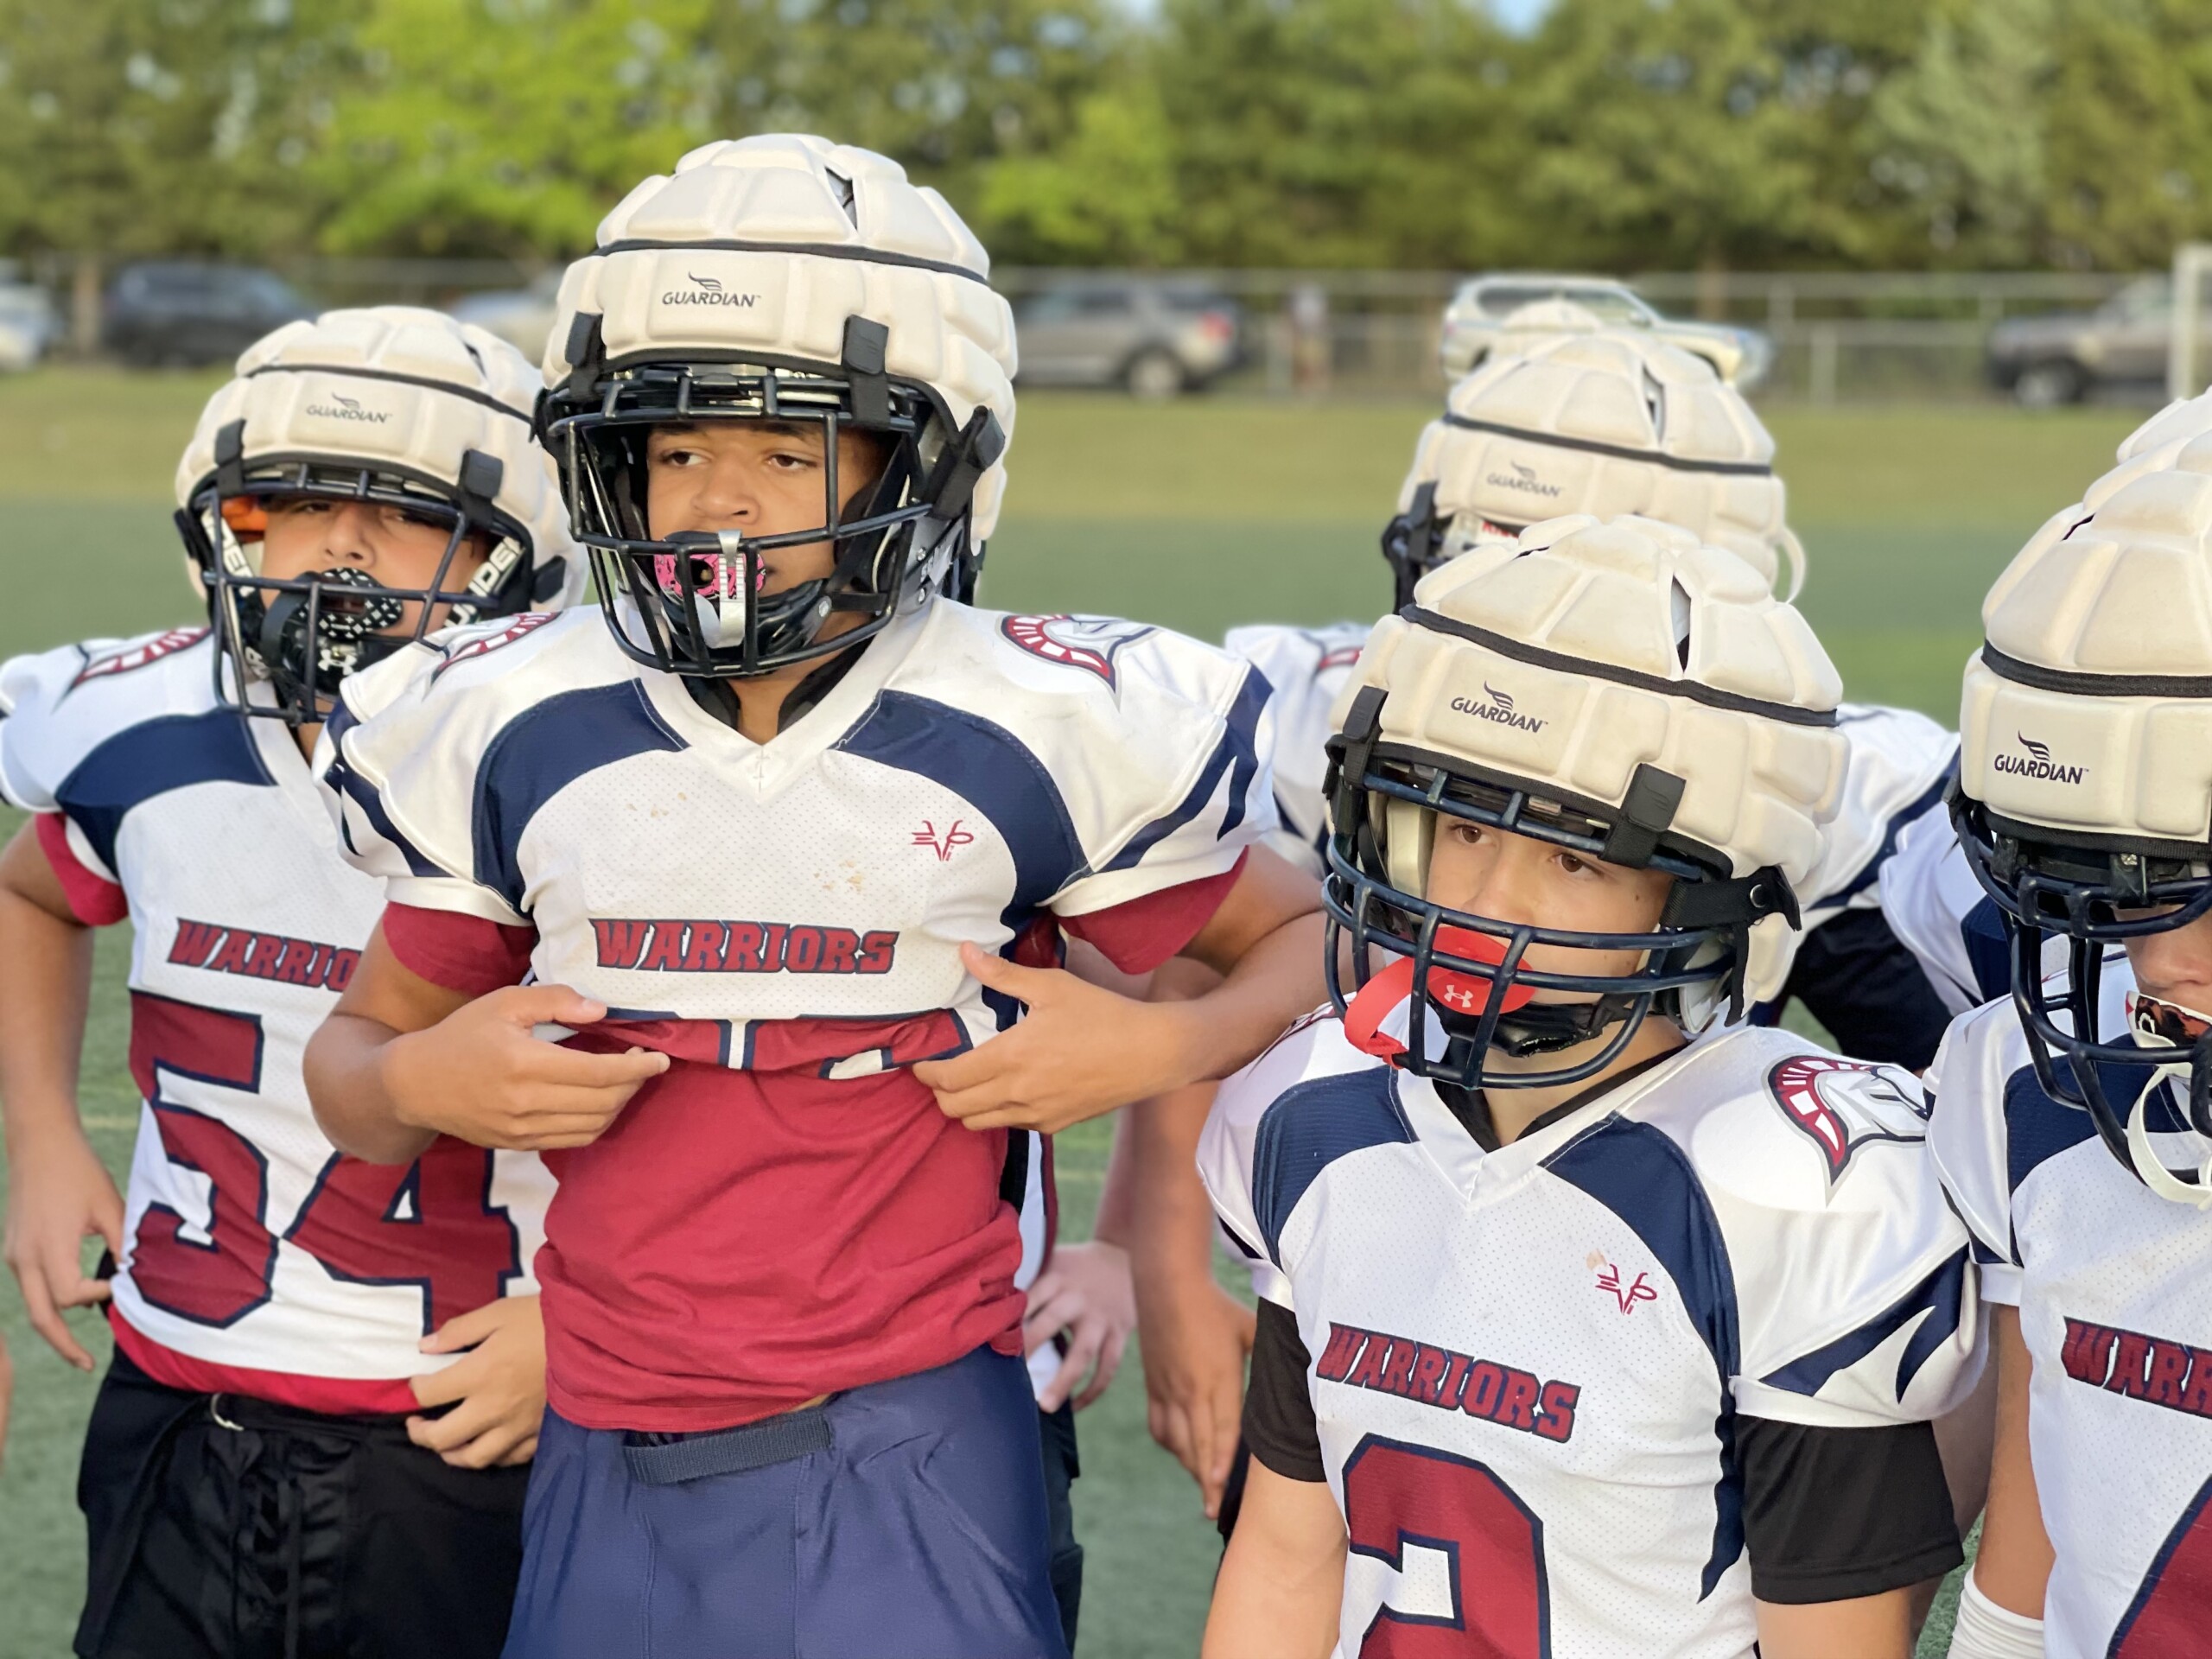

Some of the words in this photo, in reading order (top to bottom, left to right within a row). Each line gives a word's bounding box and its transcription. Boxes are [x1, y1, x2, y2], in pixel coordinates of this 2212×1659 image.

[661, 290, 756, 308] GUARDIAN
[1450, 696, 1544, 734] GUARDIAN
[1993, 753, 2083, 785] GUARDIAN
[588, 918, 900, 974] WARRIORS
[129, 988, 524, 1338] 54
[1316, 1321, 1582, 1444] WARRIORS
